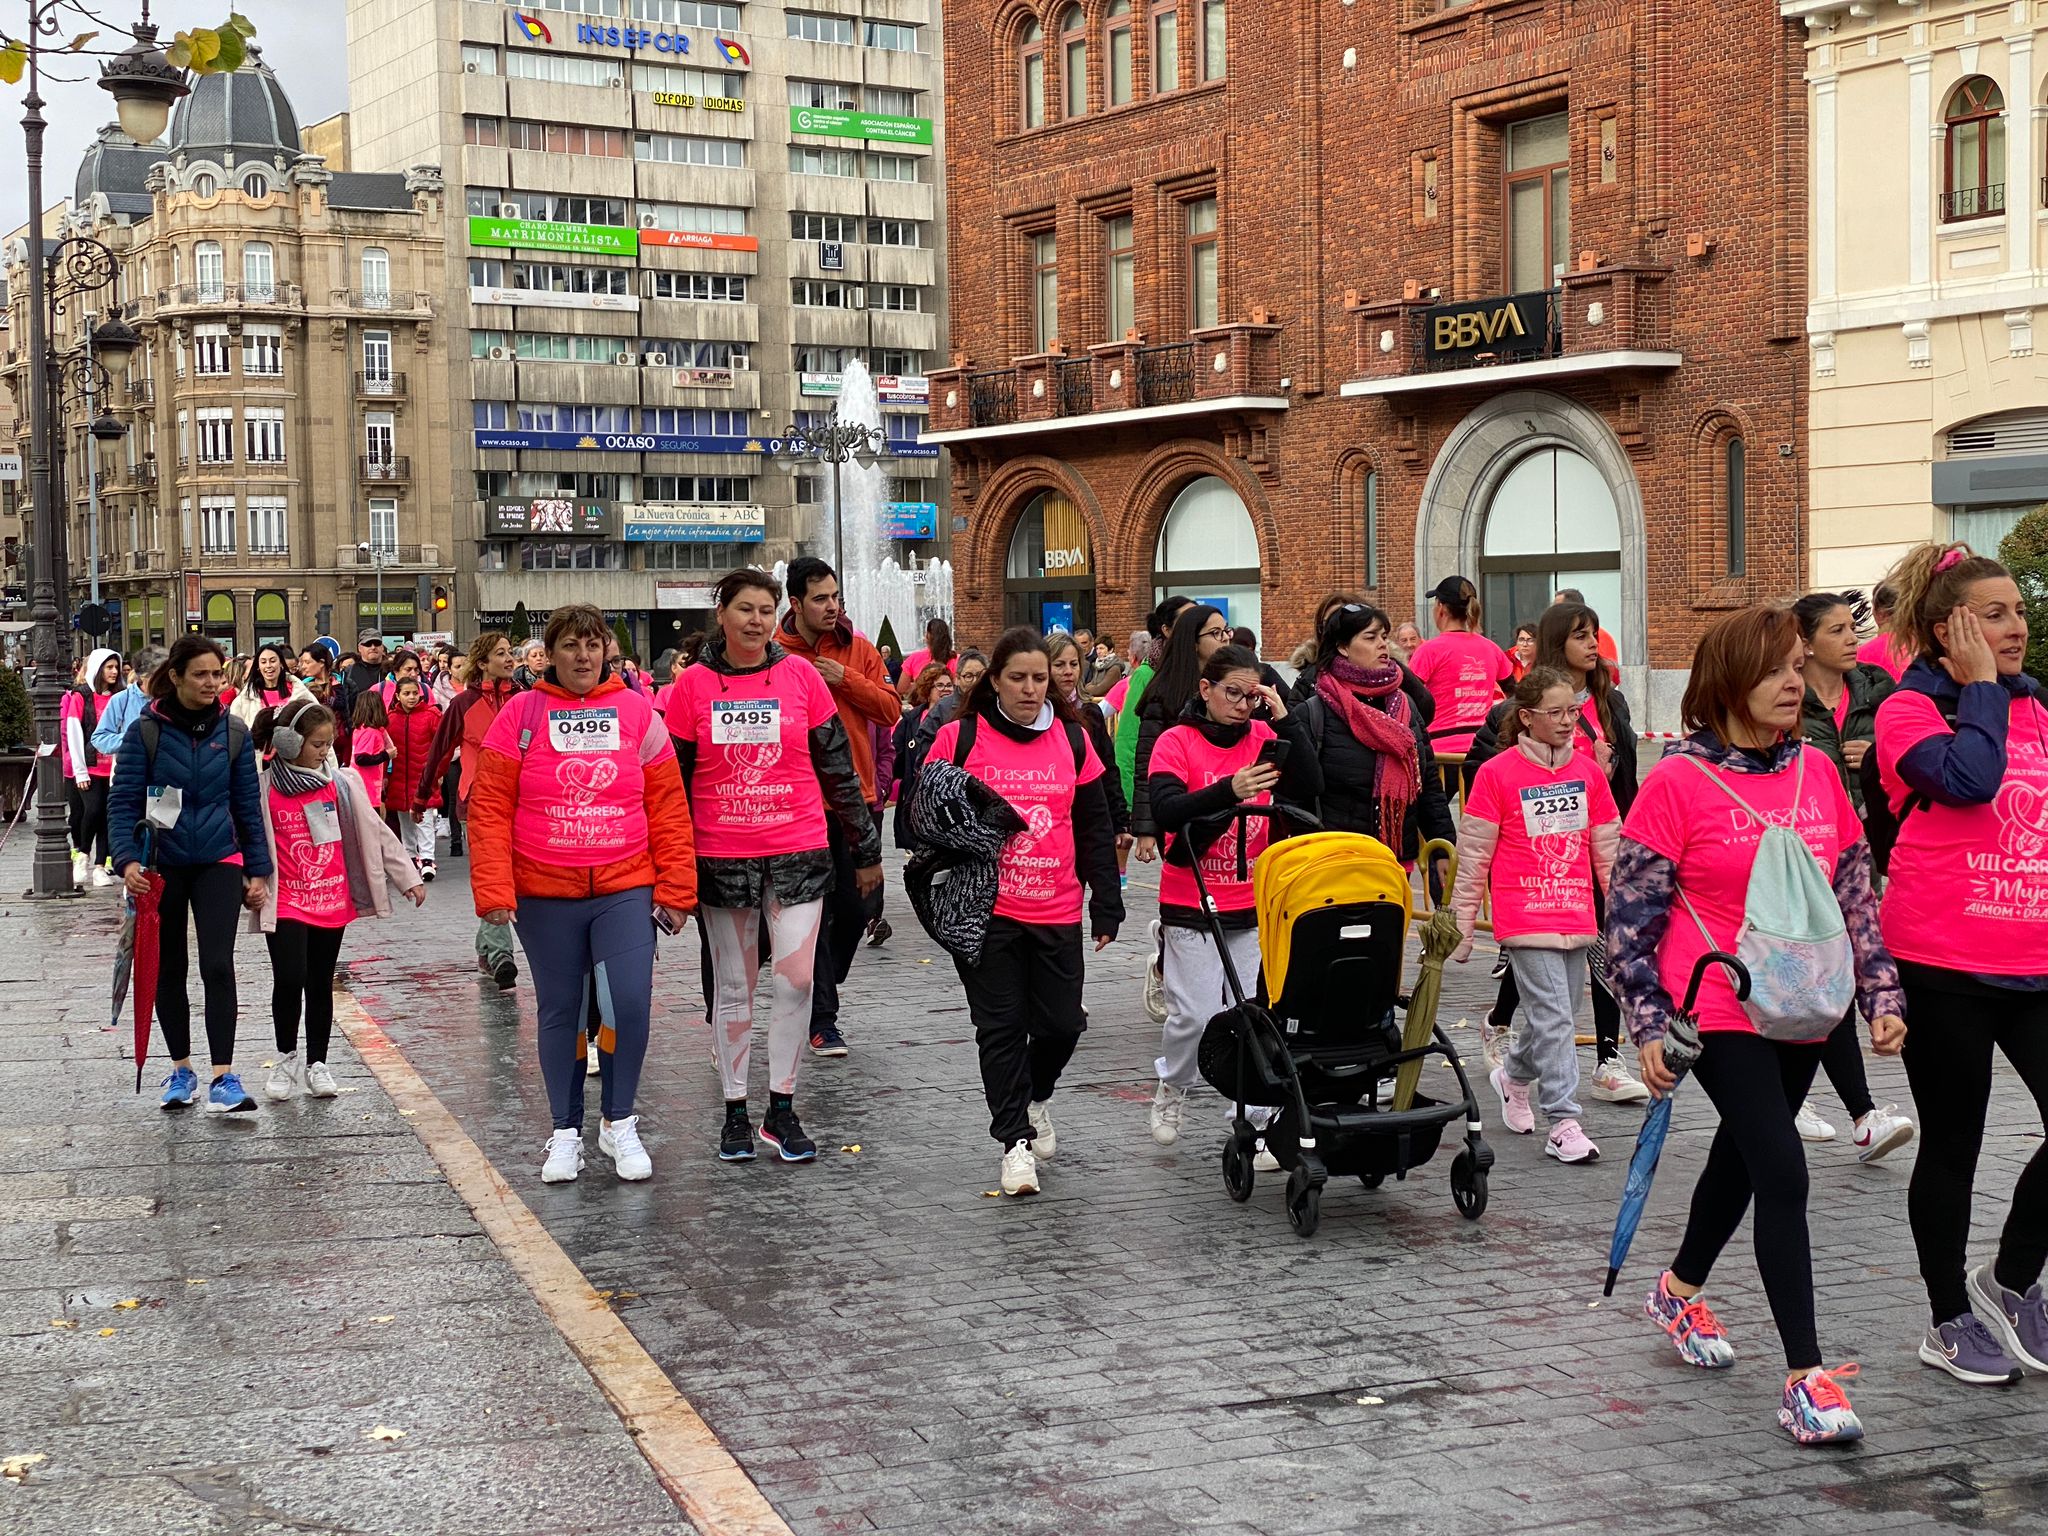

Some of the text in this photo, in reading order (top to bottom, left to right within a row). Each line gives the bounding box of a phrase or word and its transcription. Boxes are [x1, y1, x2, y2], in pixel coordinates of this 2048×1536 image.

[577, 23, 690, 54] INSEFOR
[654, 92, 743, 111] OXFORD IDIOMAS
[860, 119, 920, 130] ASOCIACIÓN ESPAÑOLA
[865, 127, 888, 135] CONTRA
[894, 129, 916, 137] CÁNCER
[519, 221, 588, 234] CHARO LLAMERA
[490, 227, 621, 246] MATRIMONIALISTA
[681, 235, 713, 243] ARRIAGA
[1434, 302, 1526, 350] BBVA
[825, 374, 843, 382] Abo
[481, 438, 529, 447] www.ocaso.es
[605, 435, 655, 449] OCASO
[660, 441, 700, 450] SEGUROS
[770, 439, 817, 452] OAS
[634, 508, 645, 519] La
[647, 508, 674, 520] Nueva
[676, 508, 710, 520] Crónica
[733, 509, 759, 520] ABC
[628, 525, 761, 540] La mejor oferta informativa de León
[1045, 546, 1084, 570] BBVA
[720, 711, 772, 725] 0495
[558, 720, 611, 734] 0496
[984, 764, 1056, 781] Drasanvi
[715, 784, 794, 796] VIII CARRERA
[1029, 783, 1069, 791] CAROBELS
[1542, 786, 1579, 797] solitium
[545, 805, 626, 817] VIII CARRERA
[731, 798, 780, 816] Mujer
[1533, 795, 1579, 816] 2323
[1729, 800, 1823, 831] Drasanvi
[561, 819, 614, 838] Mujer
[1002, 853, 1061, 869] CARRERA
[1200, 859, 1223, 871] VIII
[1966, 851, 2001, 872] VIII
[305, 873, 345, 890] CARRERA
[1000, 867, 1046, 889] Mujer
[300, 891, 338, 906] Mujer
[1015, 888, 1056, 898] DRASANVI
[1539, 883, 1583, 901] Mujer
